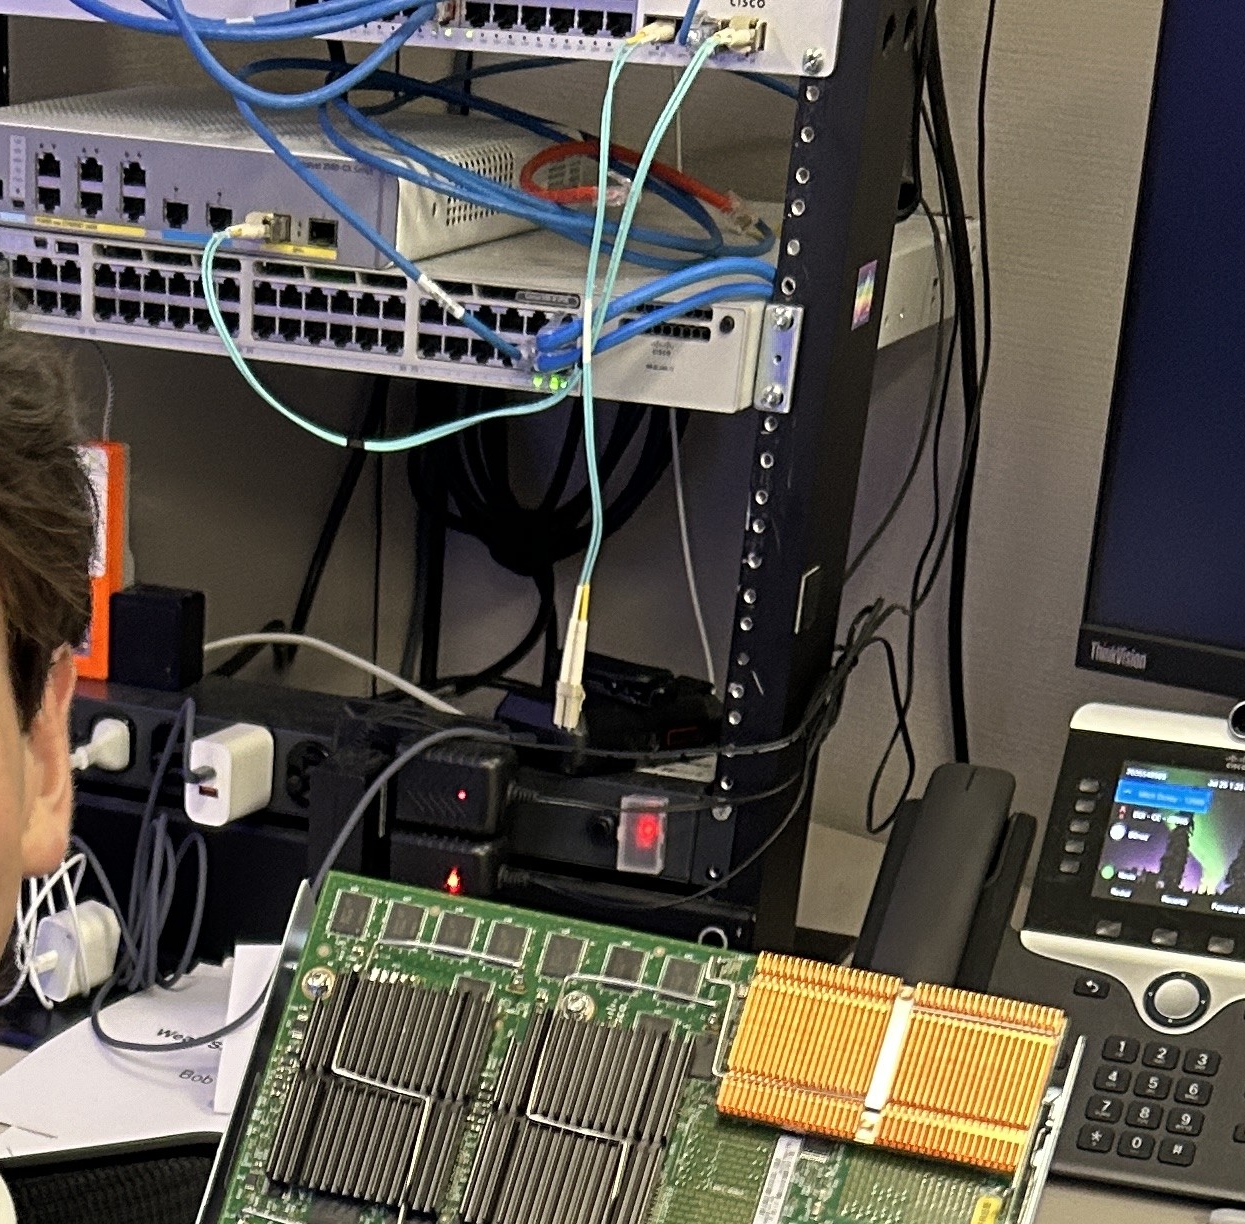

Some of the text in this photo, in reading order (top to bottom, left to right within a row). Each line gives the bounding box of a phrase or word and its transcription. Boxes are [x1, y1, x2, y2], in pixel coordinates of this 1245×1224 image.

[1119, 1040, 1126, 1053] 1
[1156, 1047, 1167, 1059] 2
[1197, 1053, 1208, 1065] 3
[1108, 1070, 1118, 1082] 4
[1148, 1076, 1159, 1089] 5
[1188, 1083, 1199, 1095] 6
[1101, 1100, 1111, 1112] 7
[1139, 1106, 1151, 1119] 8
[1181, 1113, 1192, 1126] 9
[1131, 1136, 1143, 1149] 0
